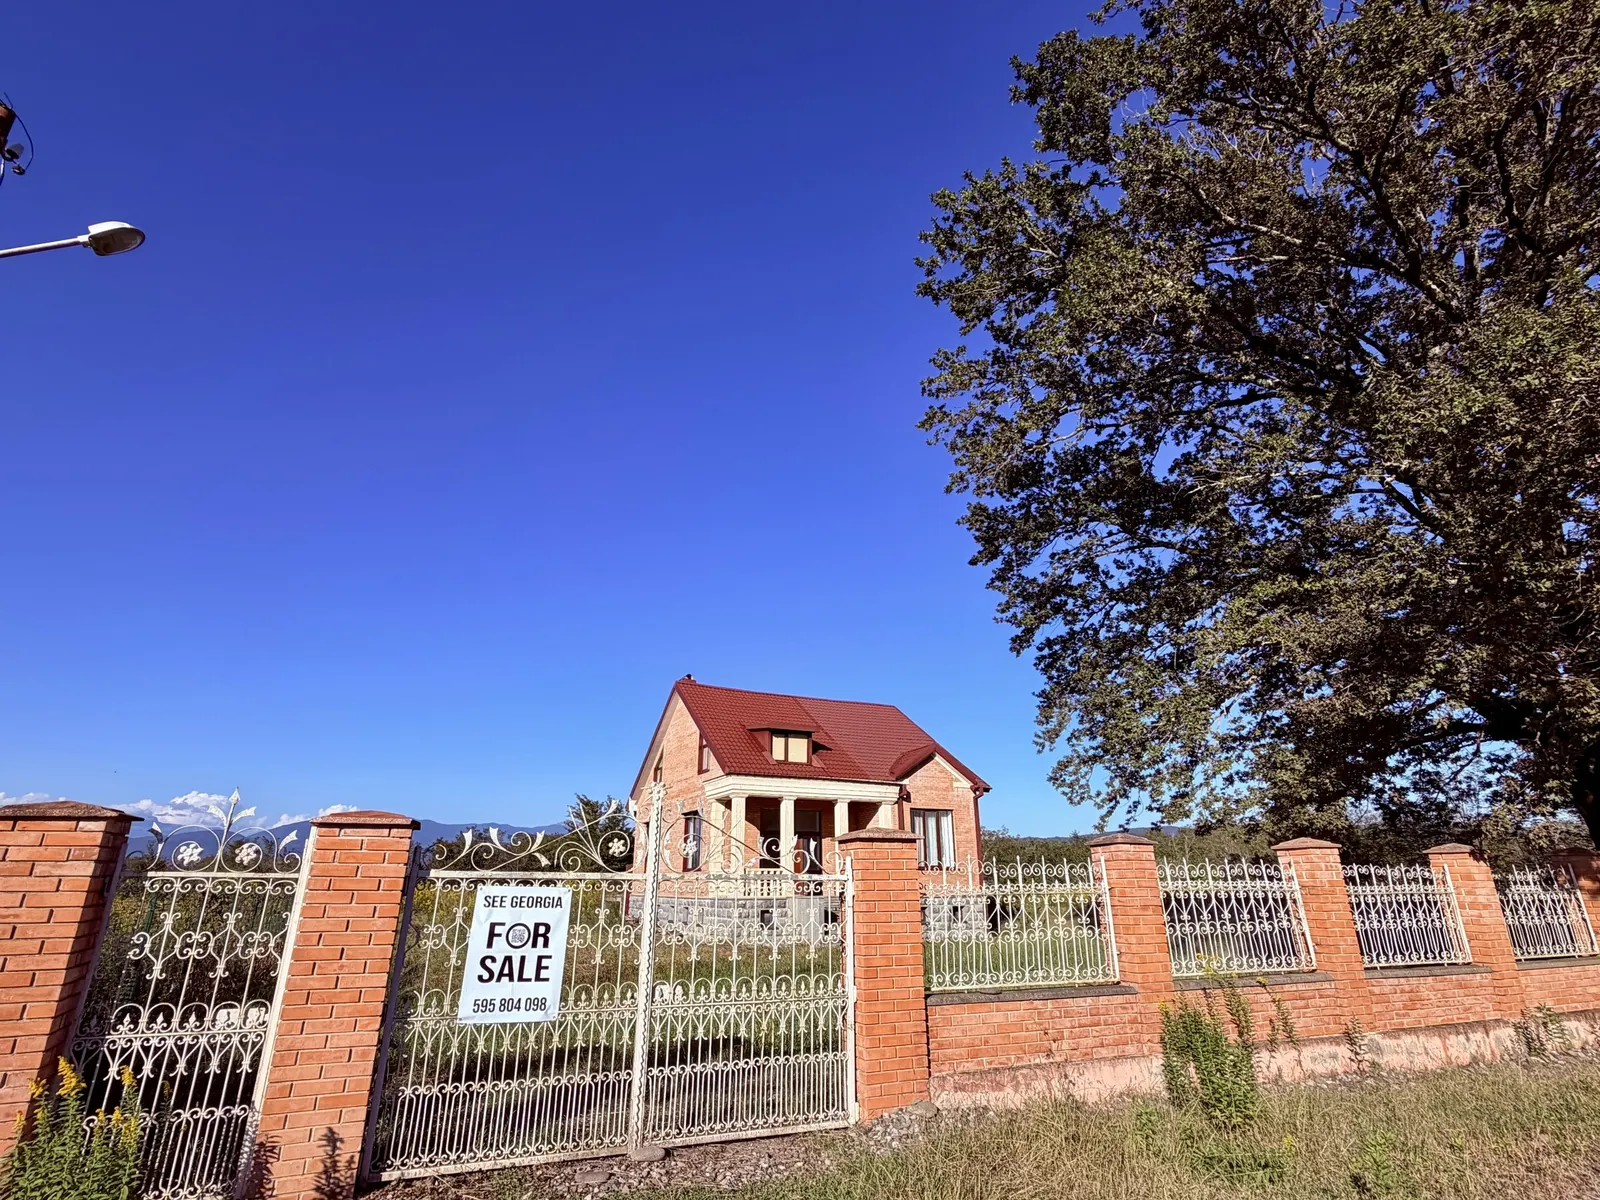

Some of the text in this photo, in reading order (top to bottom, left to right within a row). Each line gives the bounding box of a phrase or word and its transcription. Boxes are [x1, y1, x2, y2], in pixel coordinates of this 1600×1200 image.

[483, 895, 563, 909] SEE GEORGIA
[486, 922, 551, 949] FOR
[477, 955, 553, 983] SALE
[472, 997, 547, 1013] 595 804 098
